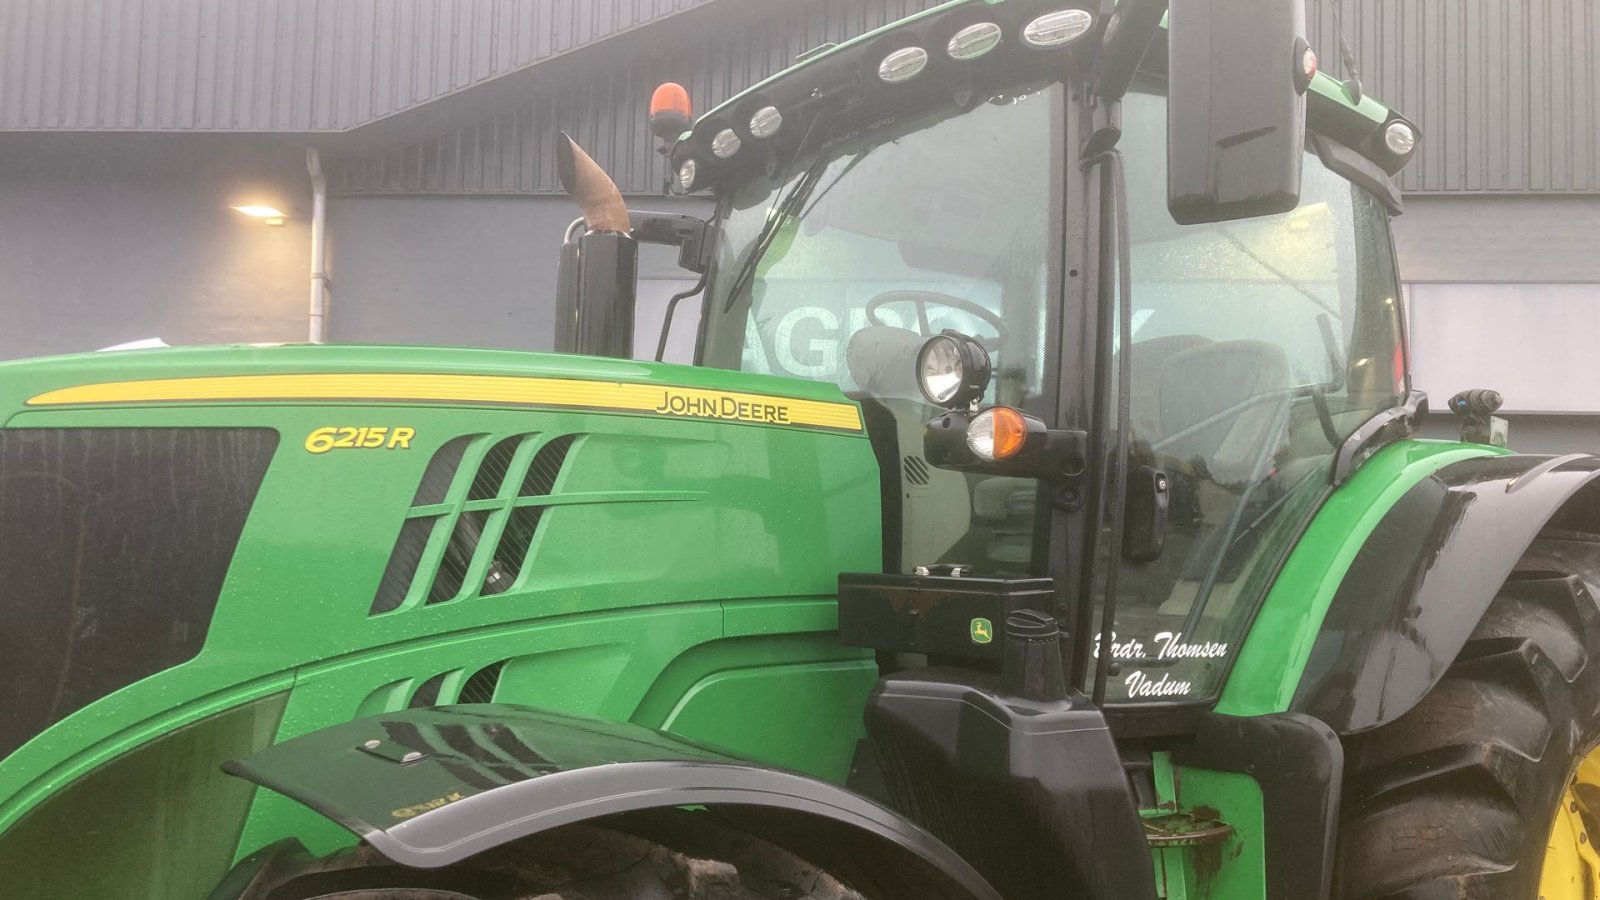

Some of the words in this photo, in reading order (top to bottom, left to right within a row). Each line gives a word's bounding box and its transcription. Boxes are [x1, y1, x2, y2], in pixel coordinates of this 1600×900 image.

[656, 391, 717, 415] JOHN
[721, 396, 790, 422] DEERE
[1153, 631, 1228, 660] Thomsen
[1124, 670, 1192, 699] Vadum
